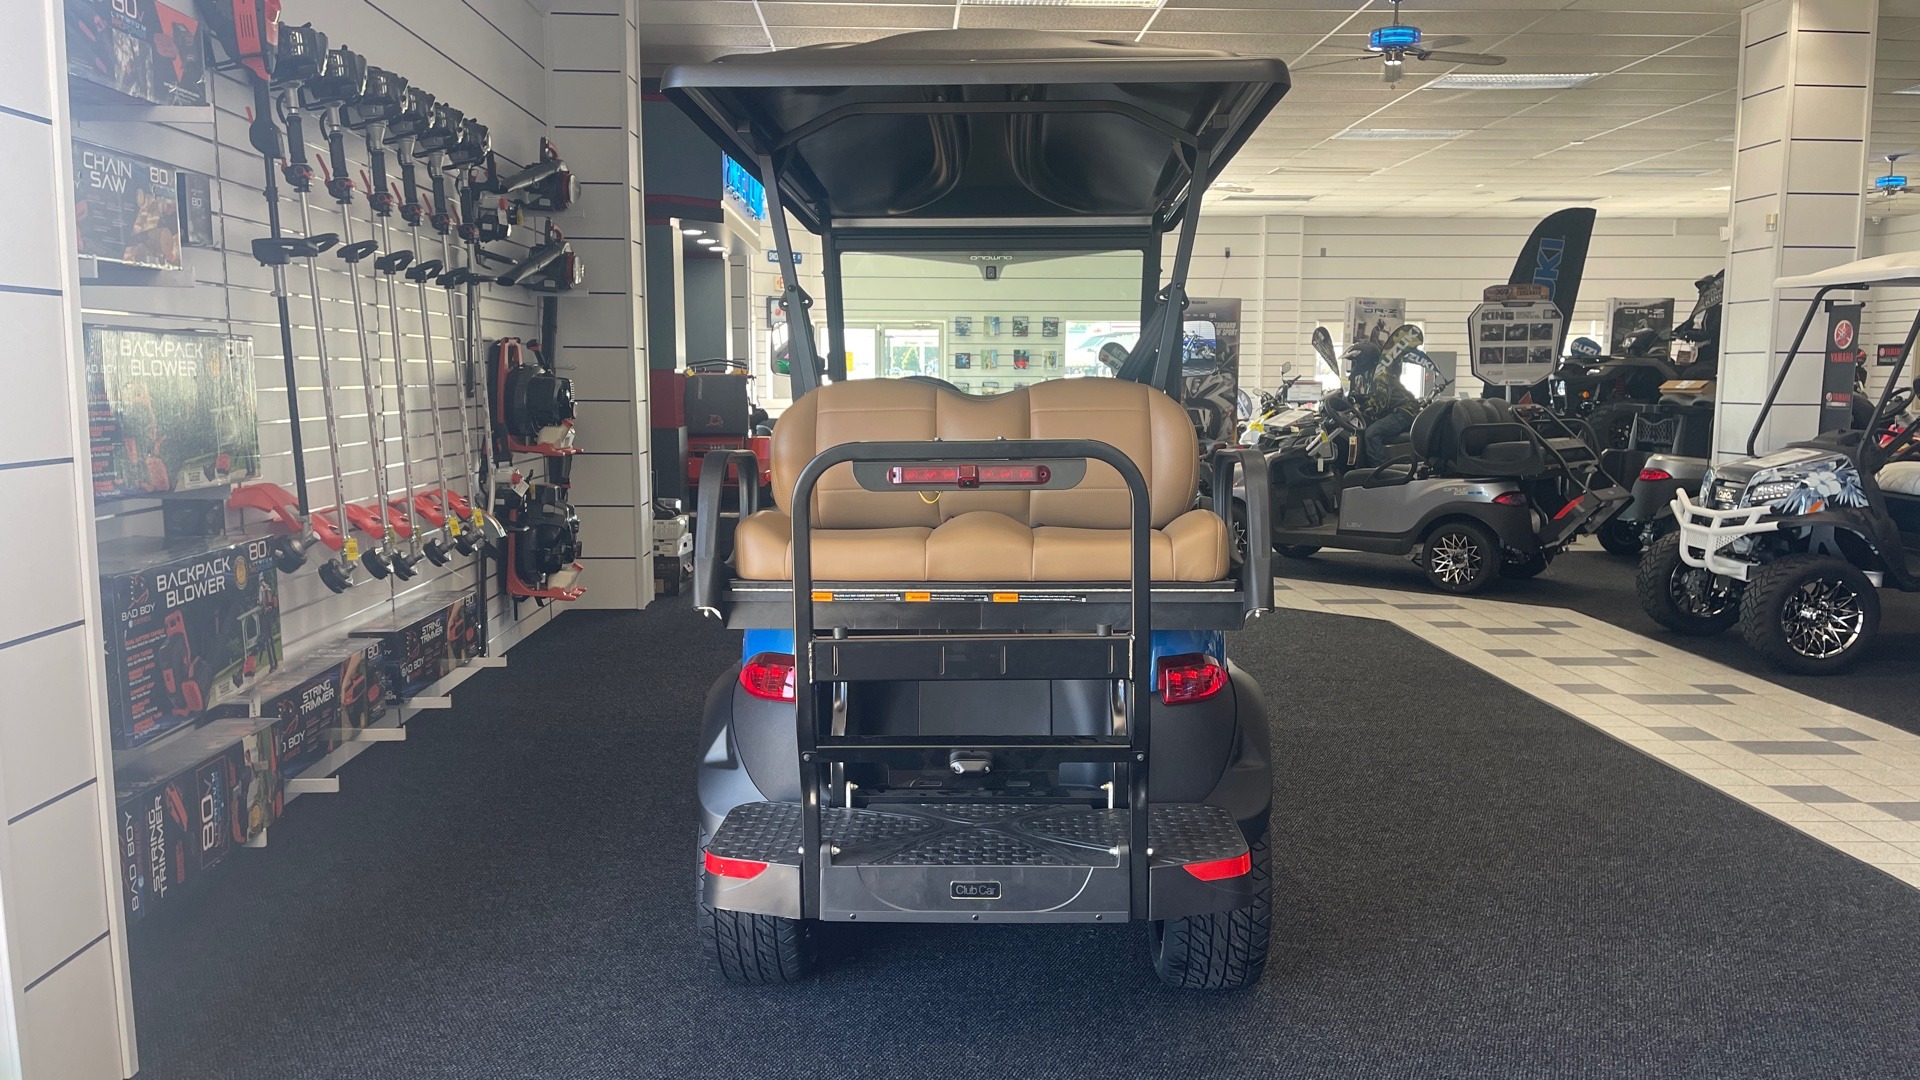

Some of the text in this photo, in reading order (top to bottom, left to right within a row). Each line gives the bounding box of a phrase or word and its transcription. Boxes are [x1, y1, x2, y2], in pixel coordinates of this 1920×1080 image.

[83, 151, 132, 179] CHAIN
[90, 170, 126, 194] SAW
[120, 338, 204, 360] BACKPACK
[1830, 352, 1854, 363] YAMAHA
[130, 359, 197, 378] BLOWER
[156, 556, 231, 593] BACKPACK
[166, 576, 226, 609] BLOWER
[121, 608, 139, 622] BAD
[139, 603, 156, 617] BOY
[420, 626, 443, 645] TRIMMER
[421, 618, 441, 635] STRING
[401, 657, 425, 678] BAD BOY
[300, 688, 335, 716] TRIMMER
[302, 679, 331, 702] STRING
[288, 730, 306, 750] BOY
[124, 811, 136, 858] BOY
[149, 809, 161, 893] STRING
[155, 795, 168, 898] TRIMMER
[128, 864, 140, 912] BAD
[955, 884, 996, 895] Club Car
